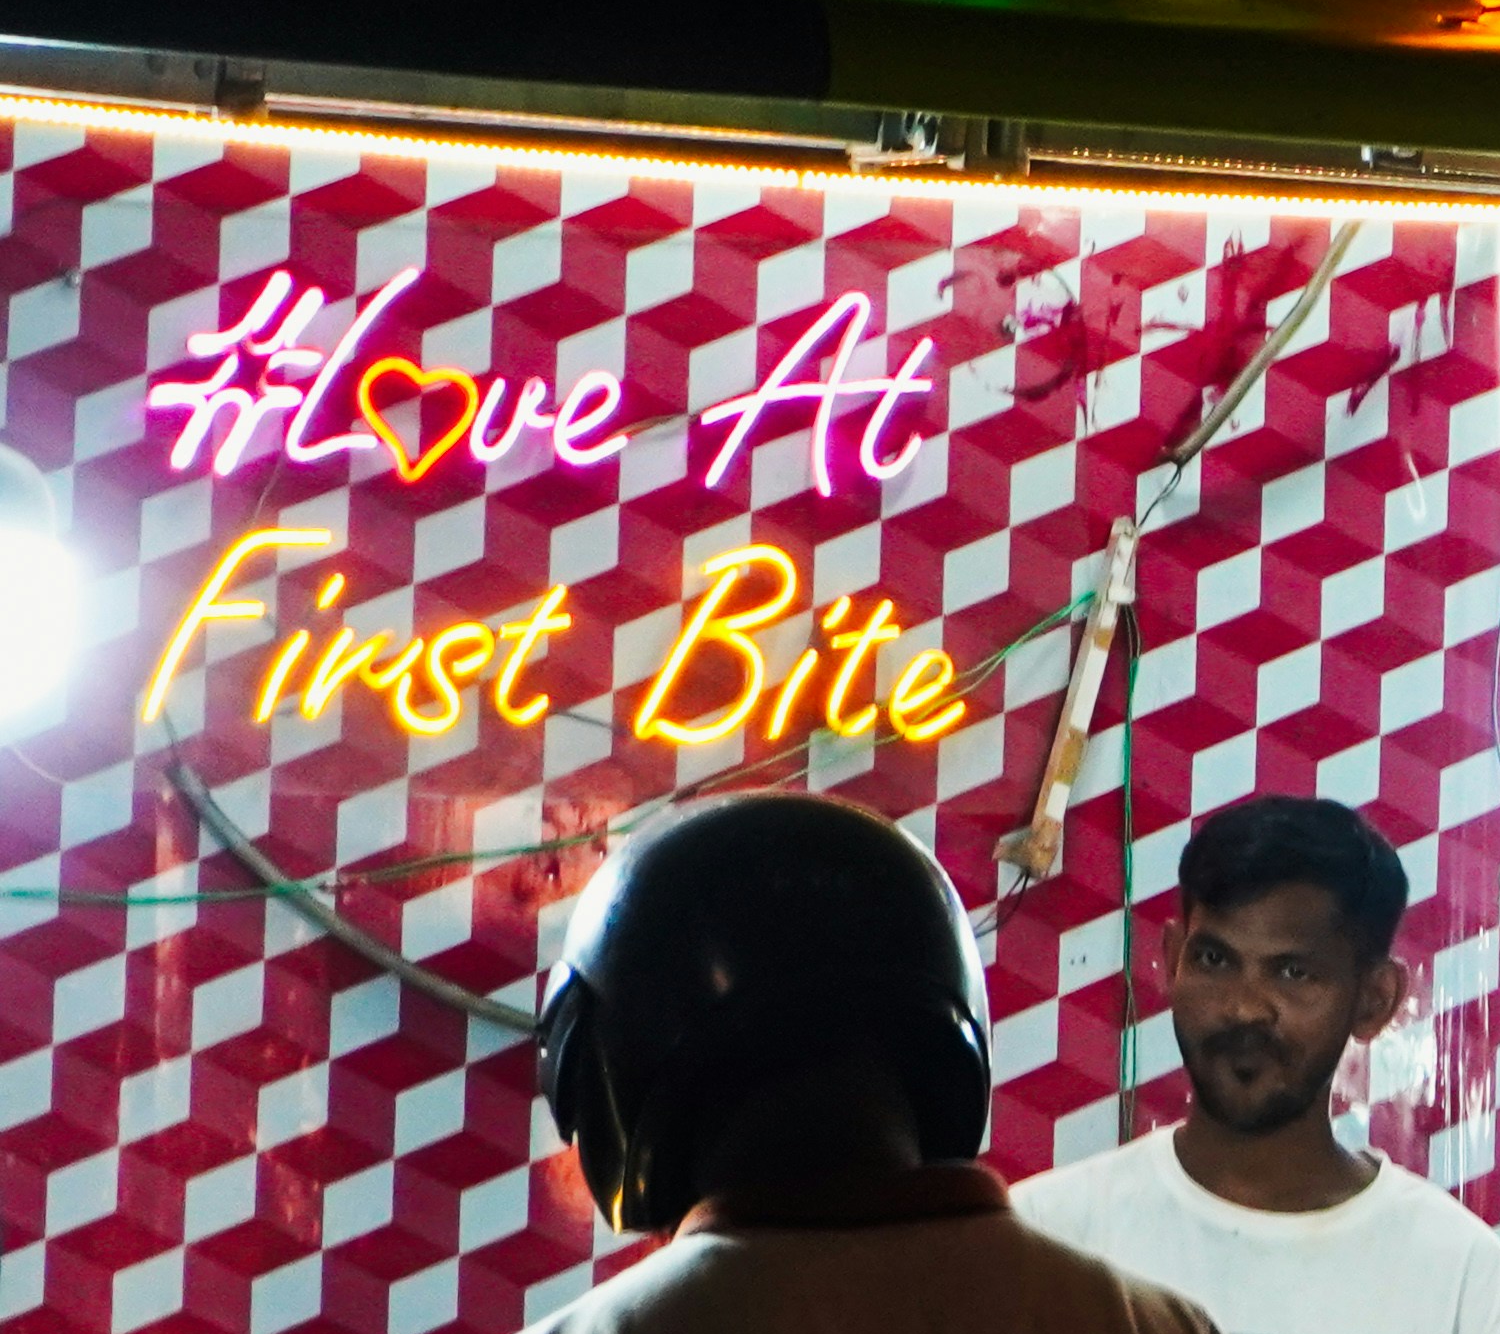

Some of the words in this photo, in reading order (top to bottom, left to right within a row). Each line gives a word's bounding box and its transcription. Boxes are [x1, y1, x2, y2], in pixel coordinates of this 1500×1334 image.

[702, 290, 935, 497] At
[142, 527, 573, 737] First
[636, 544, 968, 746] Bite
